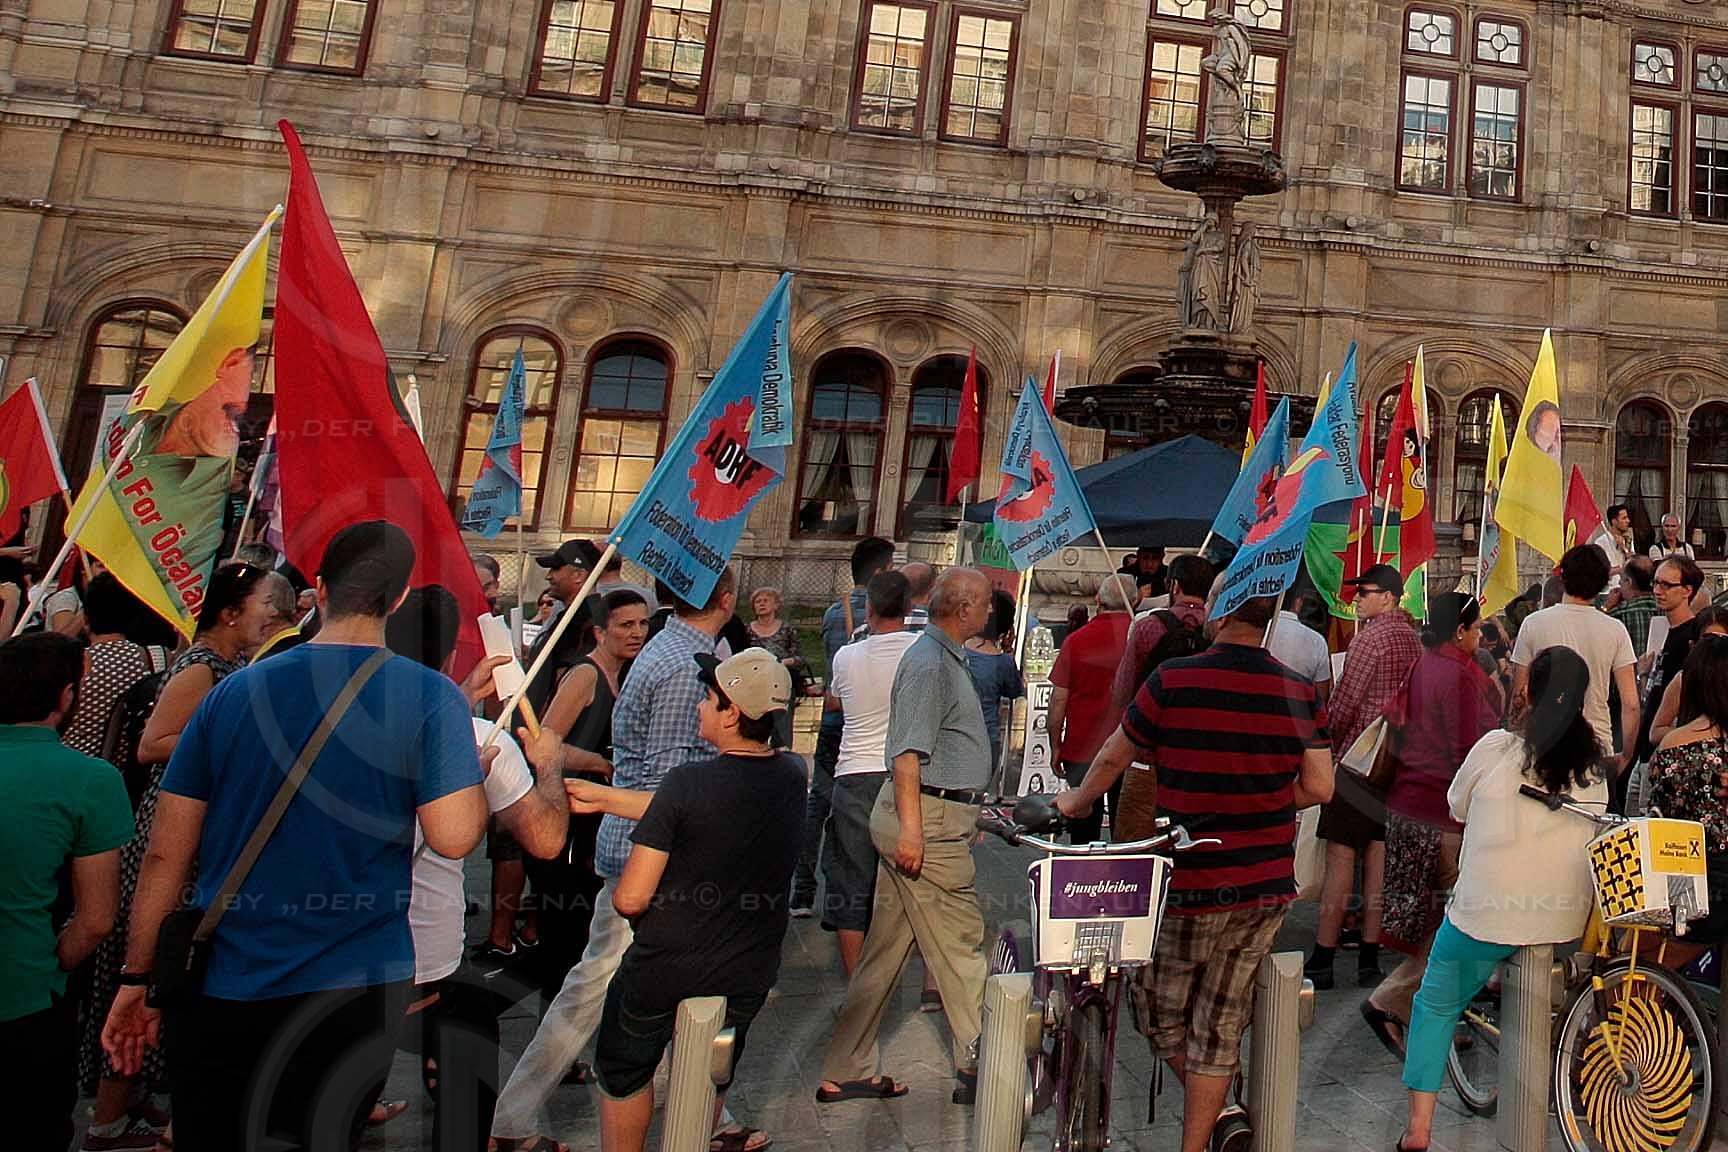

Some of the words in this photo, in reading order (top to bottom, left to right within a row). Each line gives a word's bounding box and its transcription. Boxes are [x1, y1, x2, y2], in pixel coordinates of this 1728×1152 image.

[1333, 423, 1356, 485] Federasyonu
[122, 476, 163, 528] For
[1063, 881, 1138, 898] #jungbleiben
